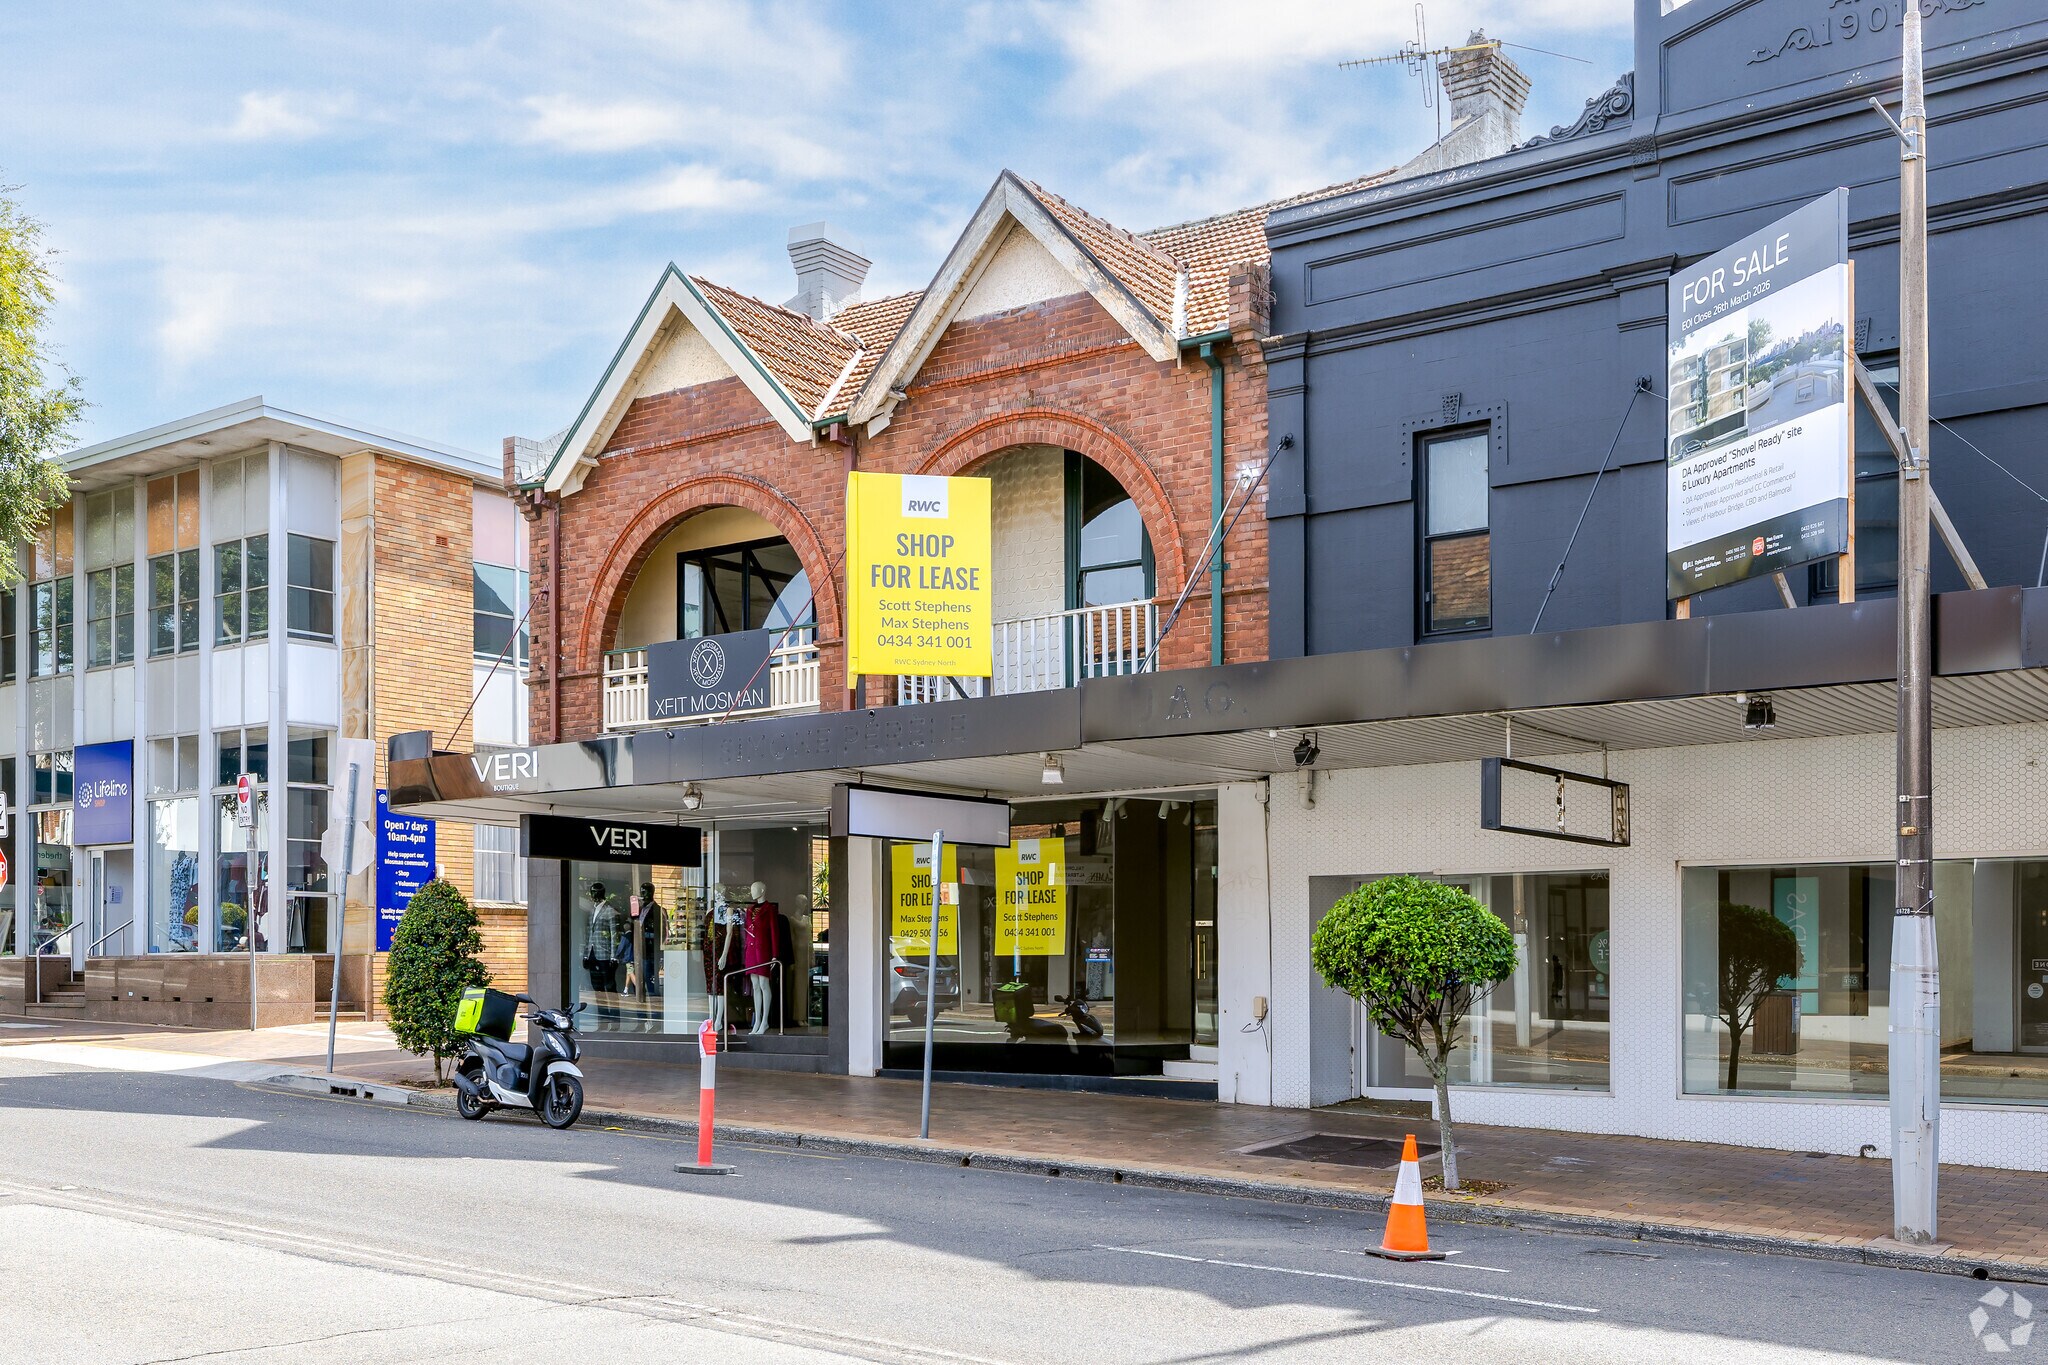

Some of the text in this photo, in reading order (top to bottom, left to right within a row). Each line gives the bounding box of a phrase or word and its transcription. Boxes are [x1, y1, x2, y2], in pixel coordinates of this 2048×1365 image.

[1682, 233, 1790, 312] FOR SALE
[1682, 280, 1770, 330] EOI Close 26th March 2026
[1682, 468, 1692, 478] DA
[1694, 456, 1727, 475] Approved
[1788, 426, 1802, 439] site
[1682, 458, 1756, 491] 6 Luxury Apartments
[1693, 488, 1716, 502] Approved
[1717, 482, 1733, 493] Luxury
[1734, 470, 1762, 486] Residential
[1769, 463, 1784, 475] Retail
[1686, 504, 1703, 516] Sydney
[1719, 490, 1743, 504] Approved
[1744, 486, 1754, 496] and
[1754, 482, 1762, 492] CC
[1763, 472, 1796, 488] Commenced
[908, 500, 940, 512] RWC
[1707, 508, 1726, 520] Harbour
[1746, 496, 1756, 506] CBD
[1758, 492, 1768, 502] and
[1768, 484, 1792, 498] Balmoral
[896, 533, 954, 558] SHOP
[871, 564, 980, 590] FOR LEASE
[879, 600, 972, 614] Scott Stephens
[882, 617, 969, 631] Max Stephens
[877, 634, 972, 649] 0434 341 001
[702, 642, 722, 660] MOSMAN
[913, 659, 935, 667] Sydney
[655, 688, 764, 716] XFIT MOSMAN
[471, 751, 538, 782] VERI
[94, 780, 128, 798] Lifeline
[494, 783, 519, 791] BOUTIQUE
[384, 820, 428, 833] Open 7 days
[387, 832, 426, 844] 10am-4pm
[590, 826, 647, 849] VERI
[388, 851, 398, 859] Help
[911, 874, 933, 888] SHO
[1016, 871, 1044, 885] SHOP
[900, 893, 918, 906] FOR
[1005, 890, 1056, 904] FOR LEASE
[917, 914, 949, 924] Stepens
[1004, 912, 1058, 922] Scott Stephens
[900, 929, 917, 938] 0429
[1025, 928, 1039, 936] 341
[1042, 928, 1056, 936] 001
